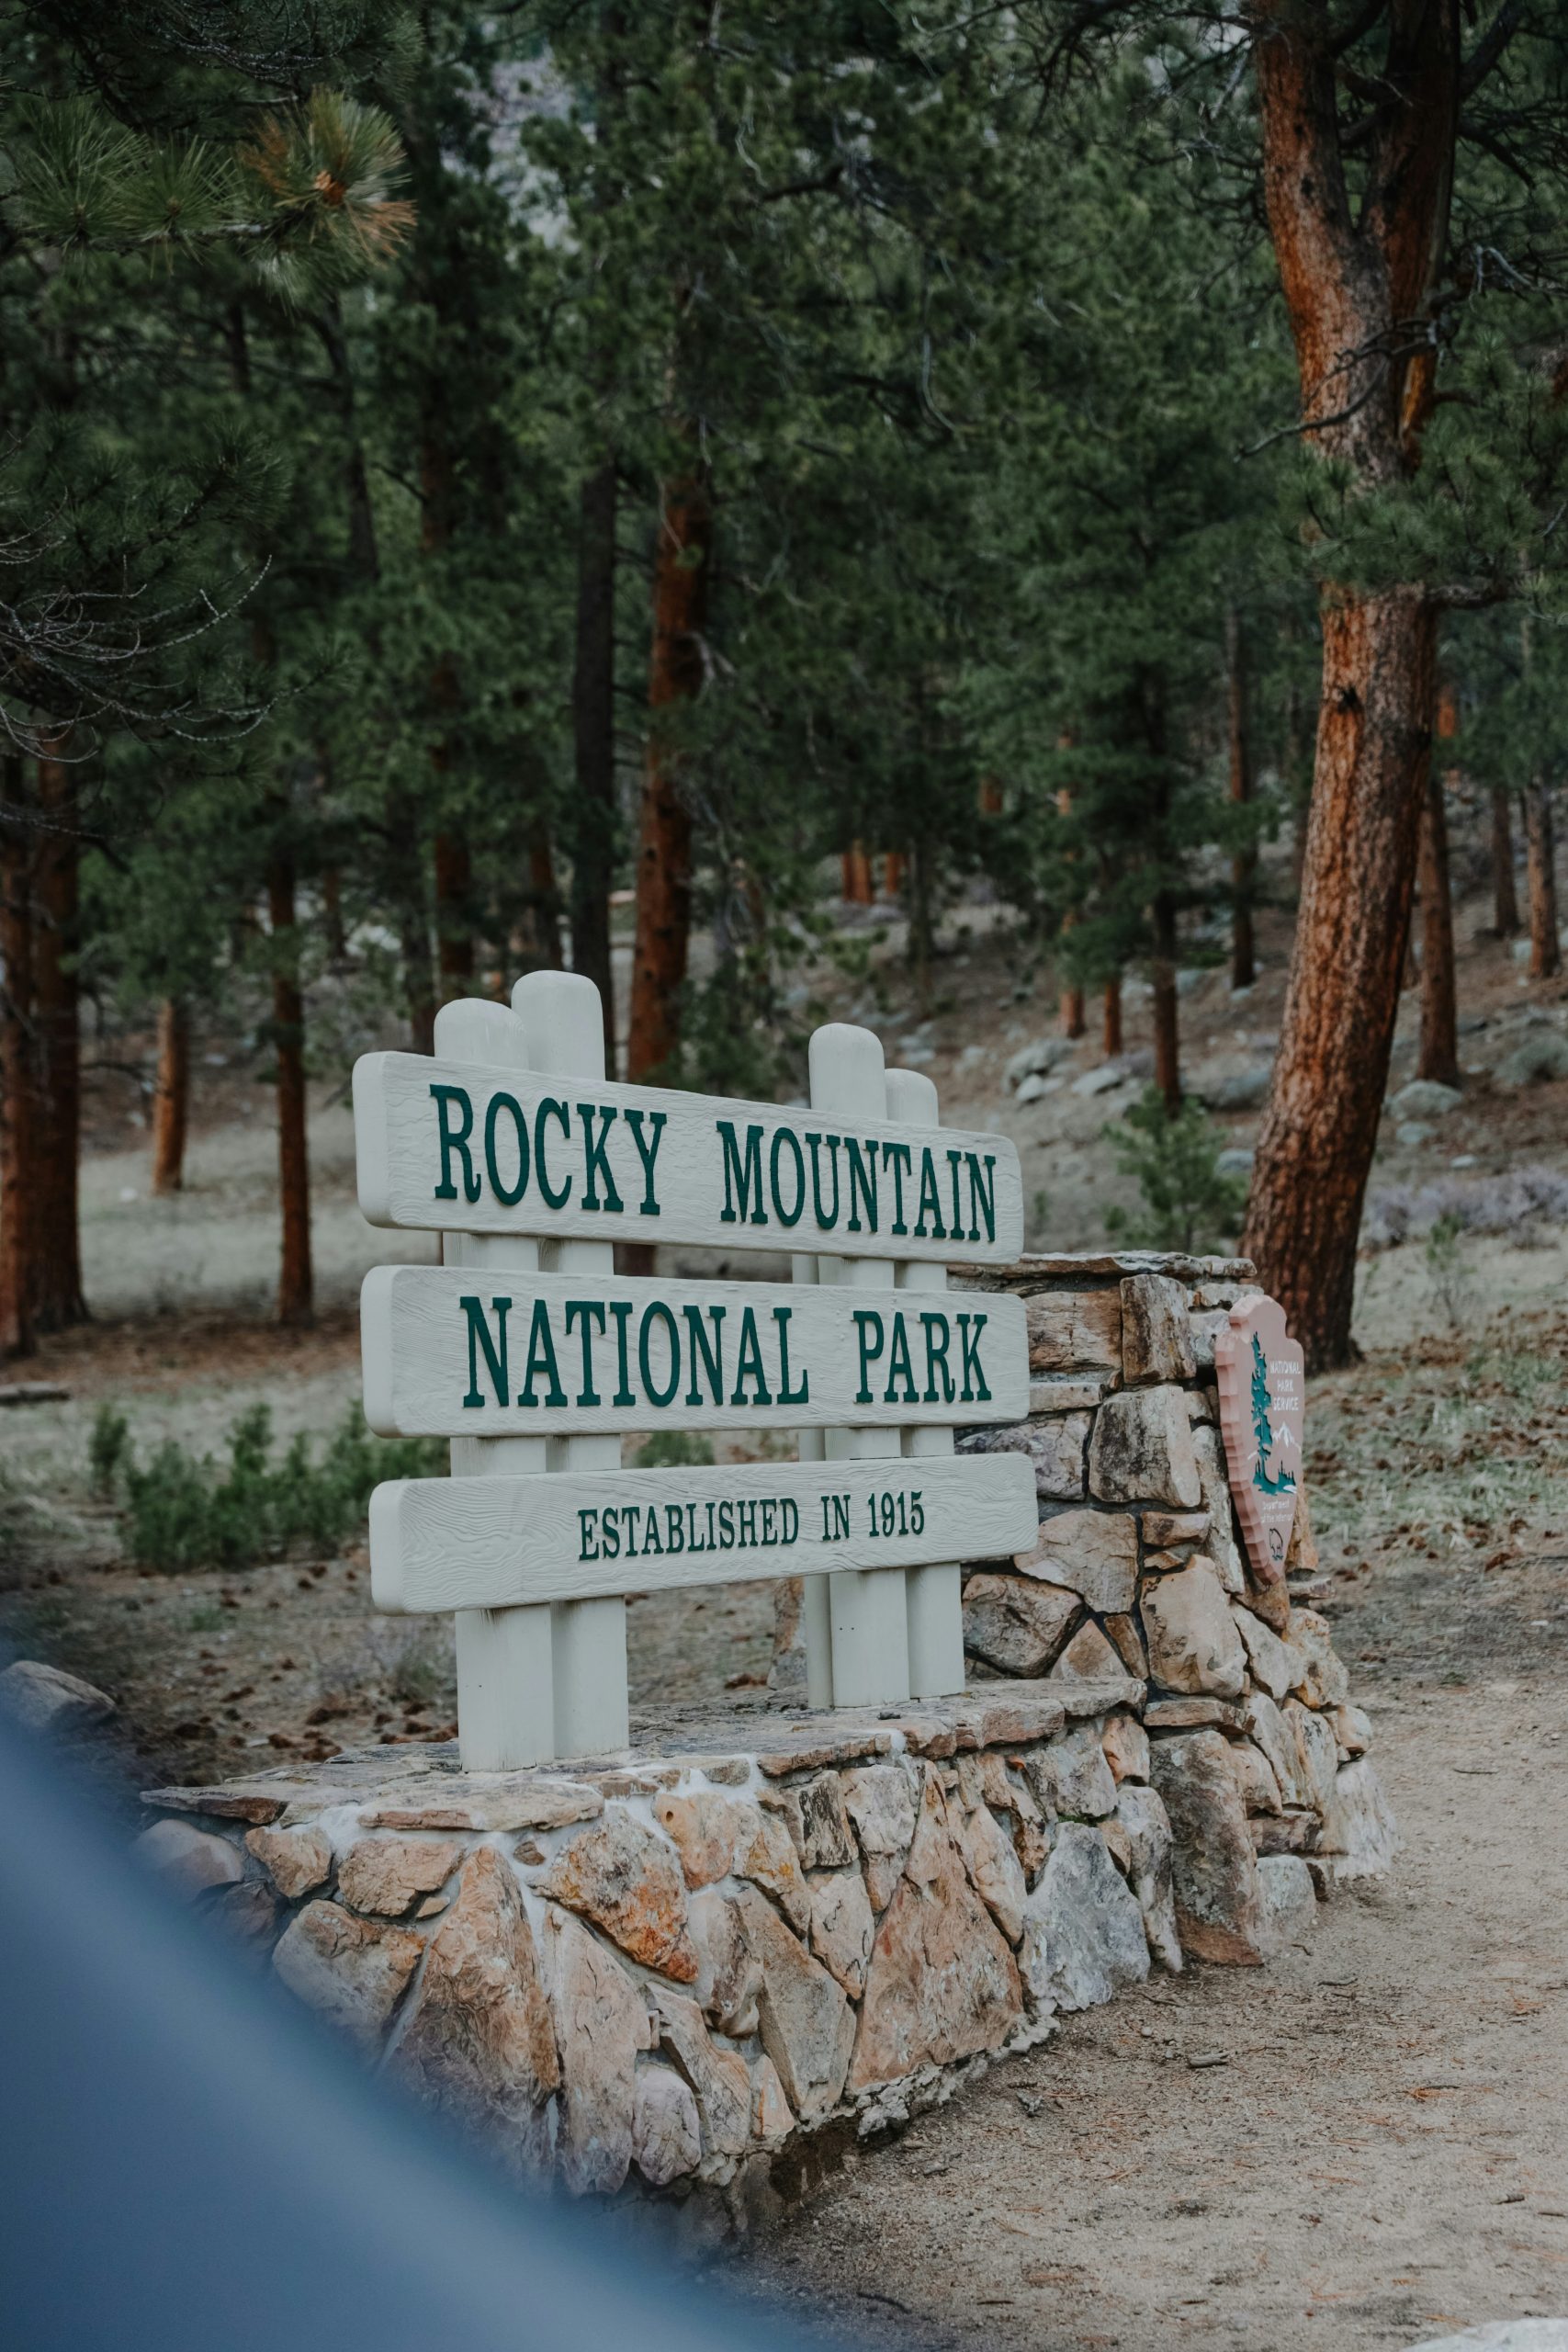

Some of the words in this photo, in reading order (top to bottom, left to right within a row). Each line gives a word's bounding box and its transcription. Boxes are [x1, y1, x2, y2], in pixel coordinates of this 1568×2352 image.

[429, 1083, 668, 1216] ROCKY
[716, 1120, 997, 1244] MOUNTAIN
[459, 1295, 809, 1408] NATIONAL
[852, 1310, 993, 1405] PARK
[1270, 1361, 1301, 1374] NATIONAL
[1273, 1396, 1299, 1411] SERVICE
[1277, 1379, 1294, 1392] PARK
[577, 1498, 800, 1562] ESTABLISHED
[821, 1494, 852, 1543] IN
[867, 1490, 926, 1538] 1915
